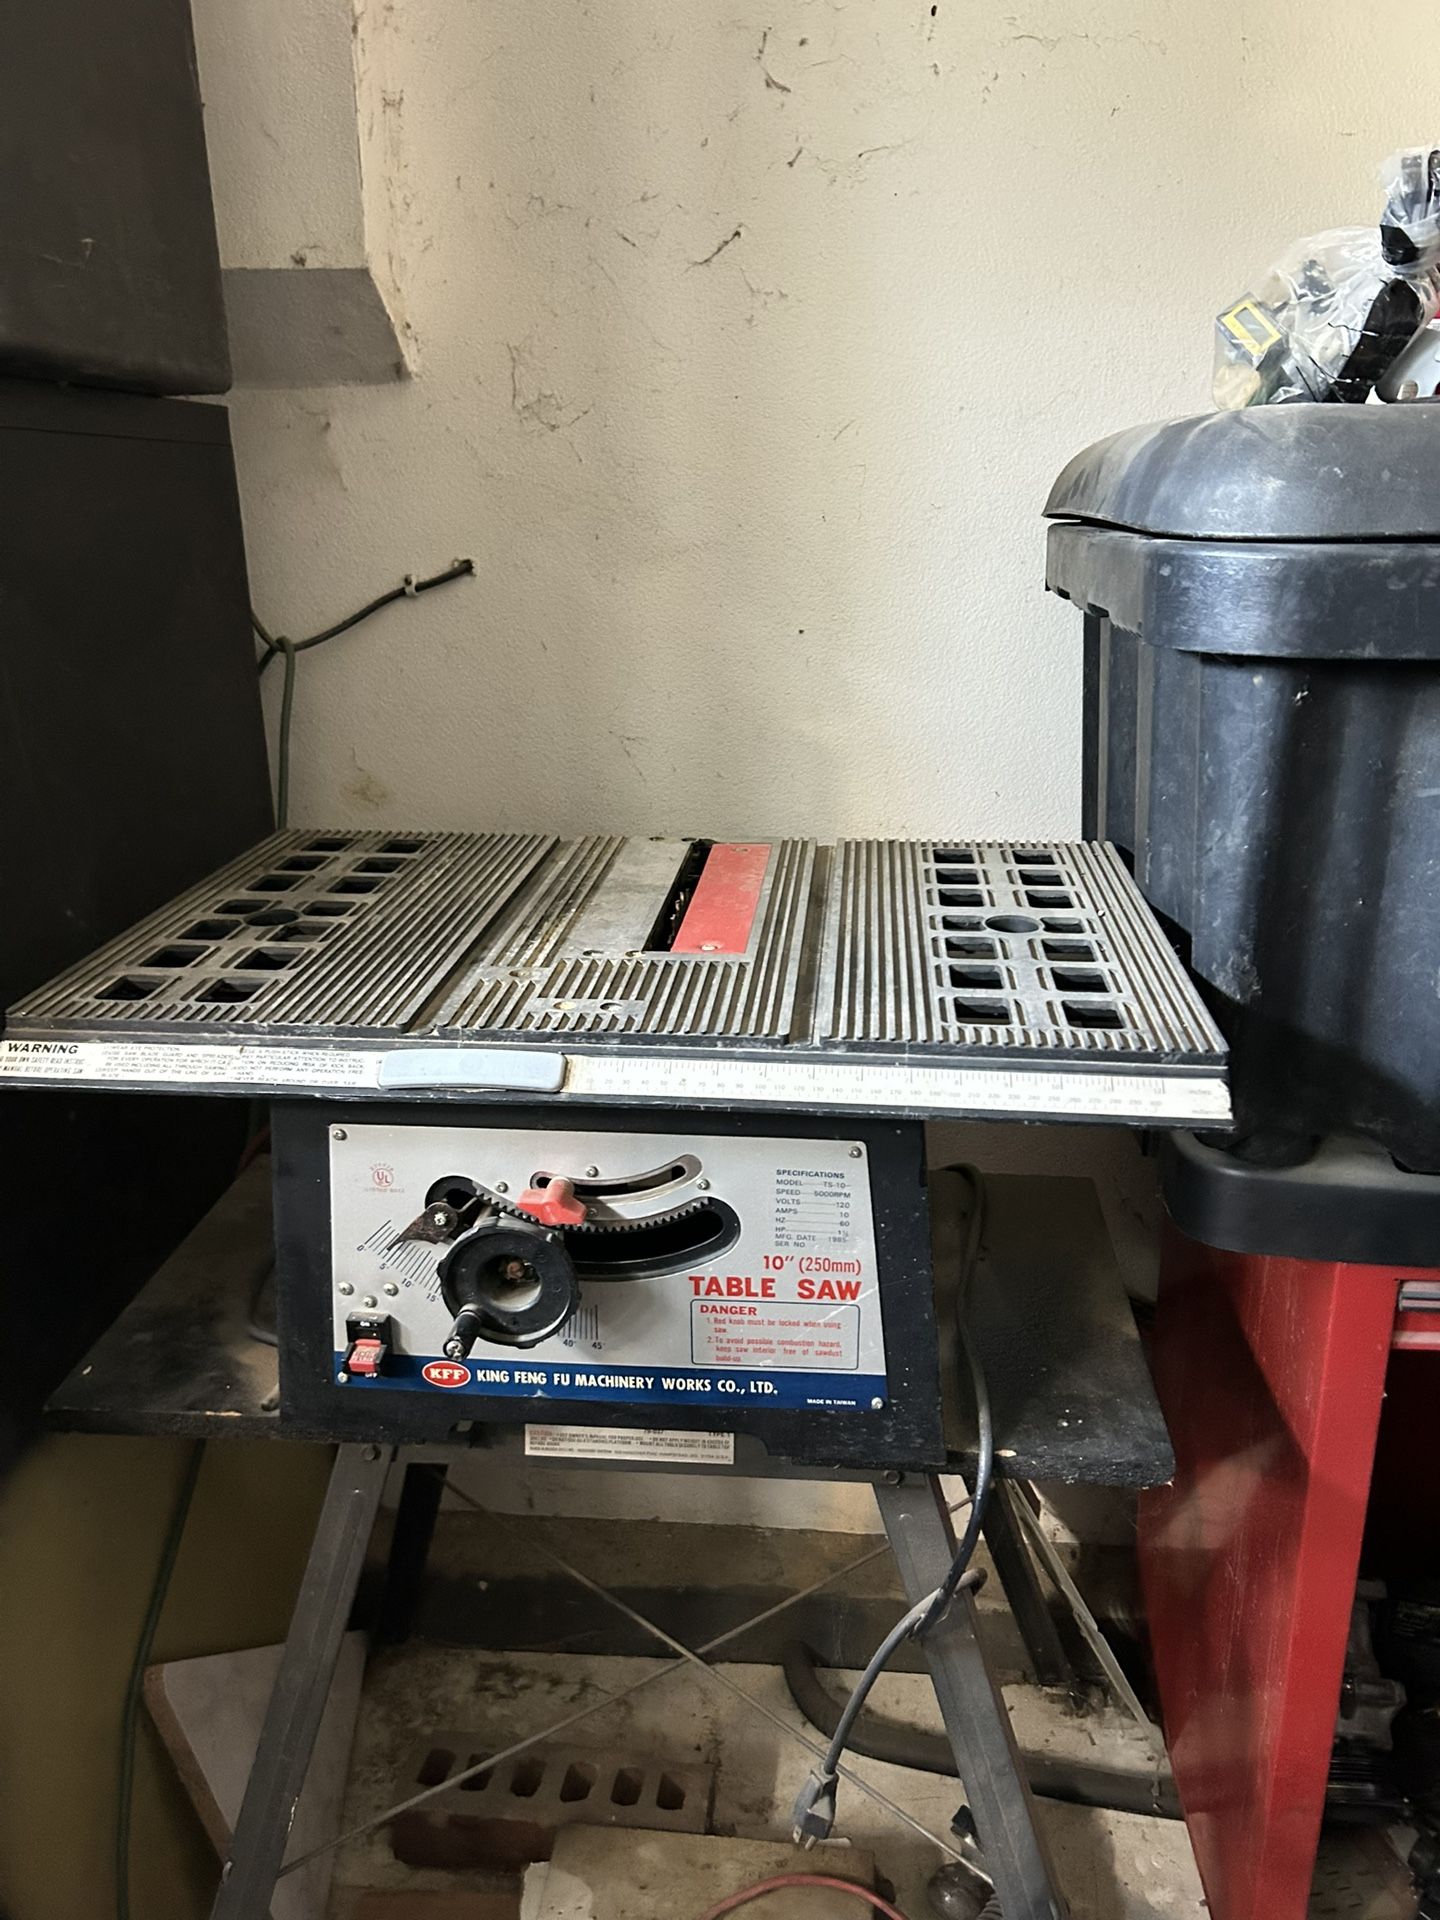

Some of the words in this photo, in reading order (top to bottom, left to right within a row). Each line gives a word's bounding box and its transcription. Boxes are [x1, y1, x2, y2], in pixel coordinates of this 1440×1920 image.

[8, 1042, 79, 1054] WARNING
[377, 1171, 390, 1184] UL
[776, 1169, 845, 1179] SPECIFICATIONS
[814, 1190, 851, 1198] 5000RPM
[799, 1257, 861, 1275] (250mm)
[688, 1276, 776, 1298] TABLE
[797, 1278, 862, 1300] SAW
[700, 1304, 757, 1316] DANGER
[777, 1339, 815, 1347] combustion
[430, 1368, 465, 1380] KFF
[476, 1369, 510, 1383] KING
[514, 1371, 547, 1384] FENG
[553, 1373, 570, 1386] FU
[575, 1374, 654, 1389] MACHINERY
[661, 1378, 711, 1392] WORKS
[717, 1379, 746, 1395] CO.,
[750, 1381, 778, 1395] LTD.
